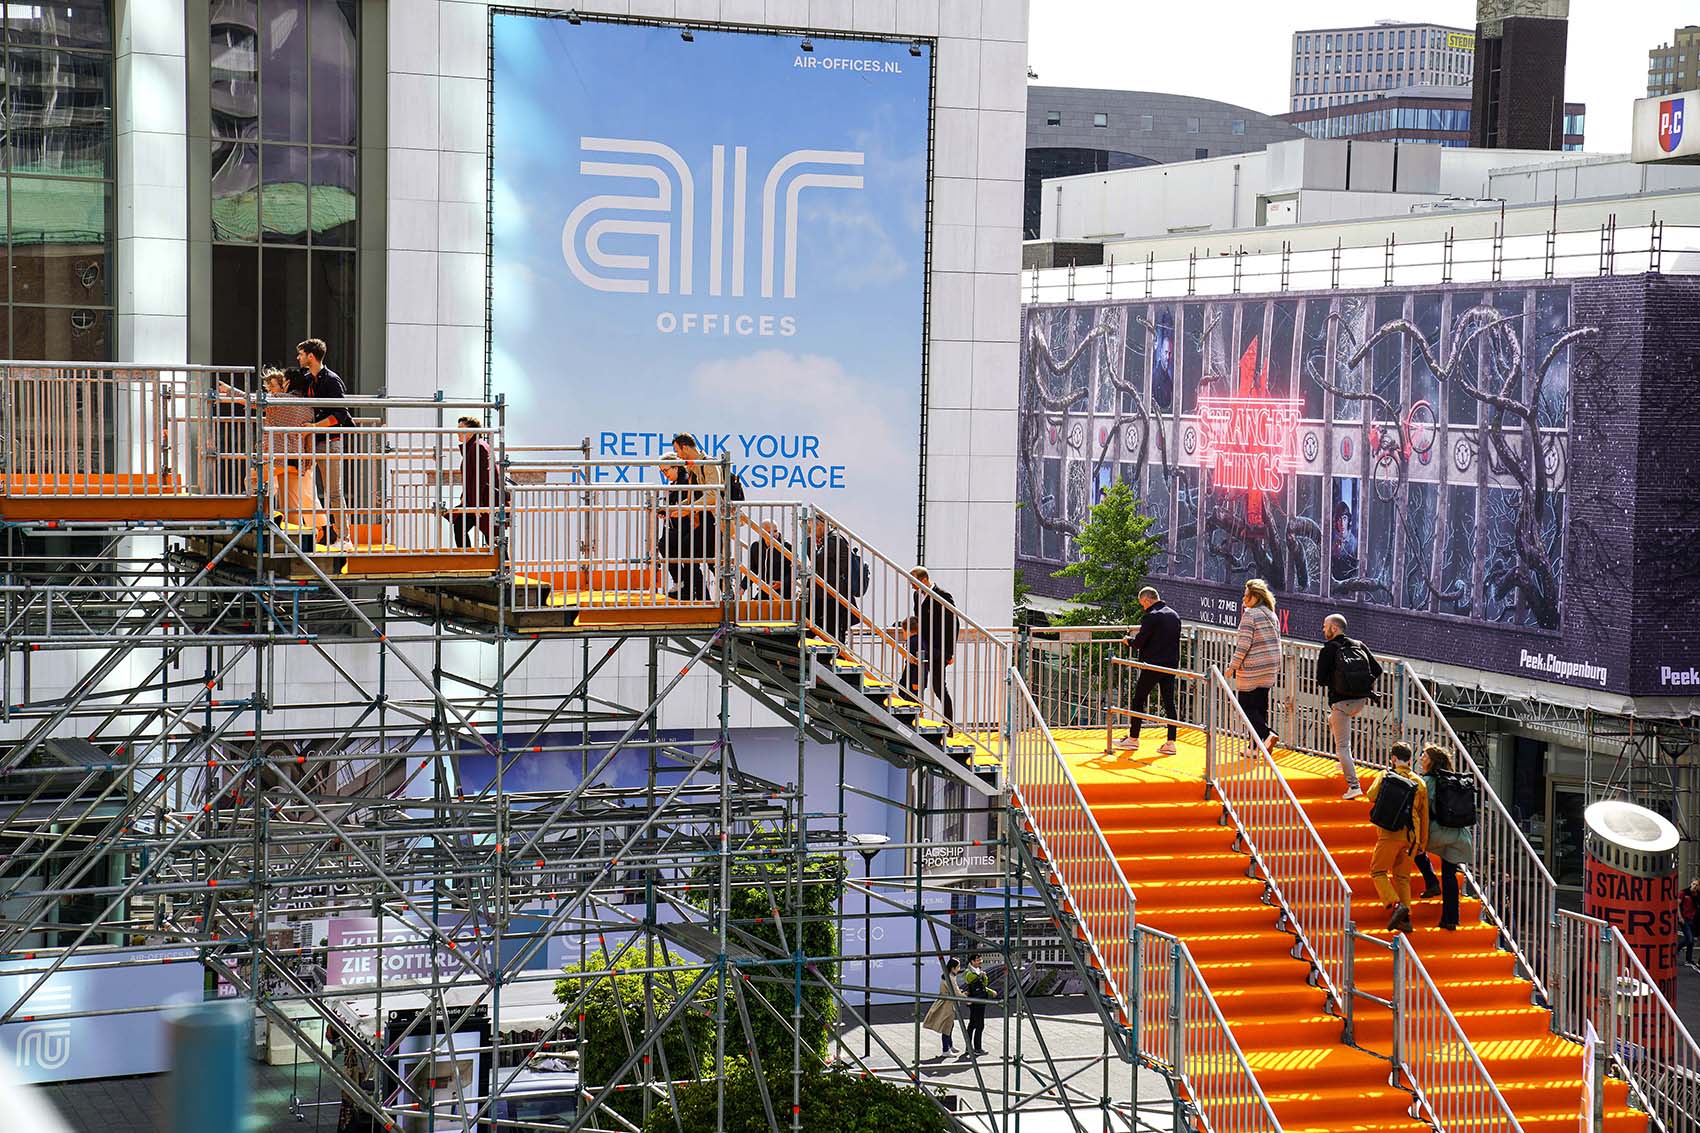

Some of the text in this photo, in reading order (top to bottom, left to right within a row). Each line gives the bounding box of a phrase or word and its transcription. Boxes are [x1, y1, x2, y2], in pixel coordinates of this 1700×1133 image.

[793, 55, 902, 73] AIR-OFFICES.NL
[1660, 110, 1682, 136] P&C
[562, 136, 864, 299] air
[656, 311, 798, 336] OFFICES
[1197, 405, 1302, 457] STRANGER
[600, 431, 819, 459] RETHNK YOUR
[1213, 450, 1284, 493] THINGS
[1225, 600, 1238, 612] MEI
[1222, 614, 1237, 626] JULI
[1660, 666, 1700, 686] Peek
[923, 846, 964, 857] AGSHIP
[1596, 871, 1654, 902] START
[342, 956, 371, 973] ZIE
